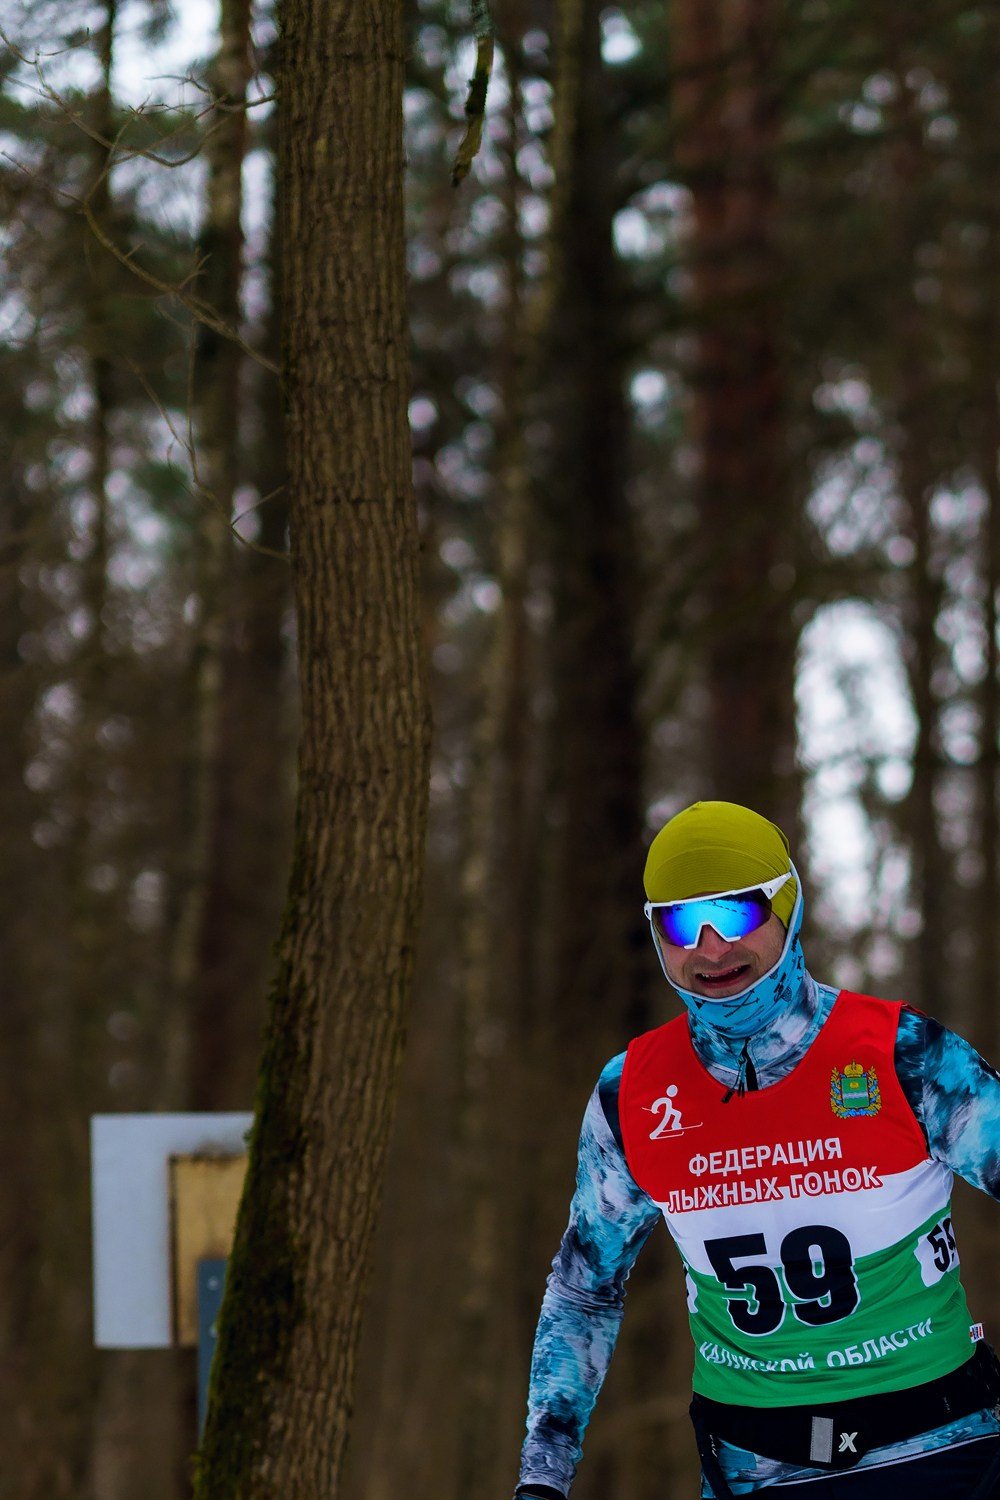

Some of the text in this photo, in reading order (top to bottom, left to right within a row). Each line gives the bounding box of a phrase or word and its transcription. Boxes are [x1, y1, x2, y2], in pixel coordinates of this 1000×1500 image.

[688, 1137, 843, 1177] ФЕДЕРАЦИЯ
[667, 1165, 884, 1214] ЛЫЖНЫХ ГОНОК
[703, 1223, 860, 1337] 59
[826, 1317, 933, 1368] ОБЛАСТИ
